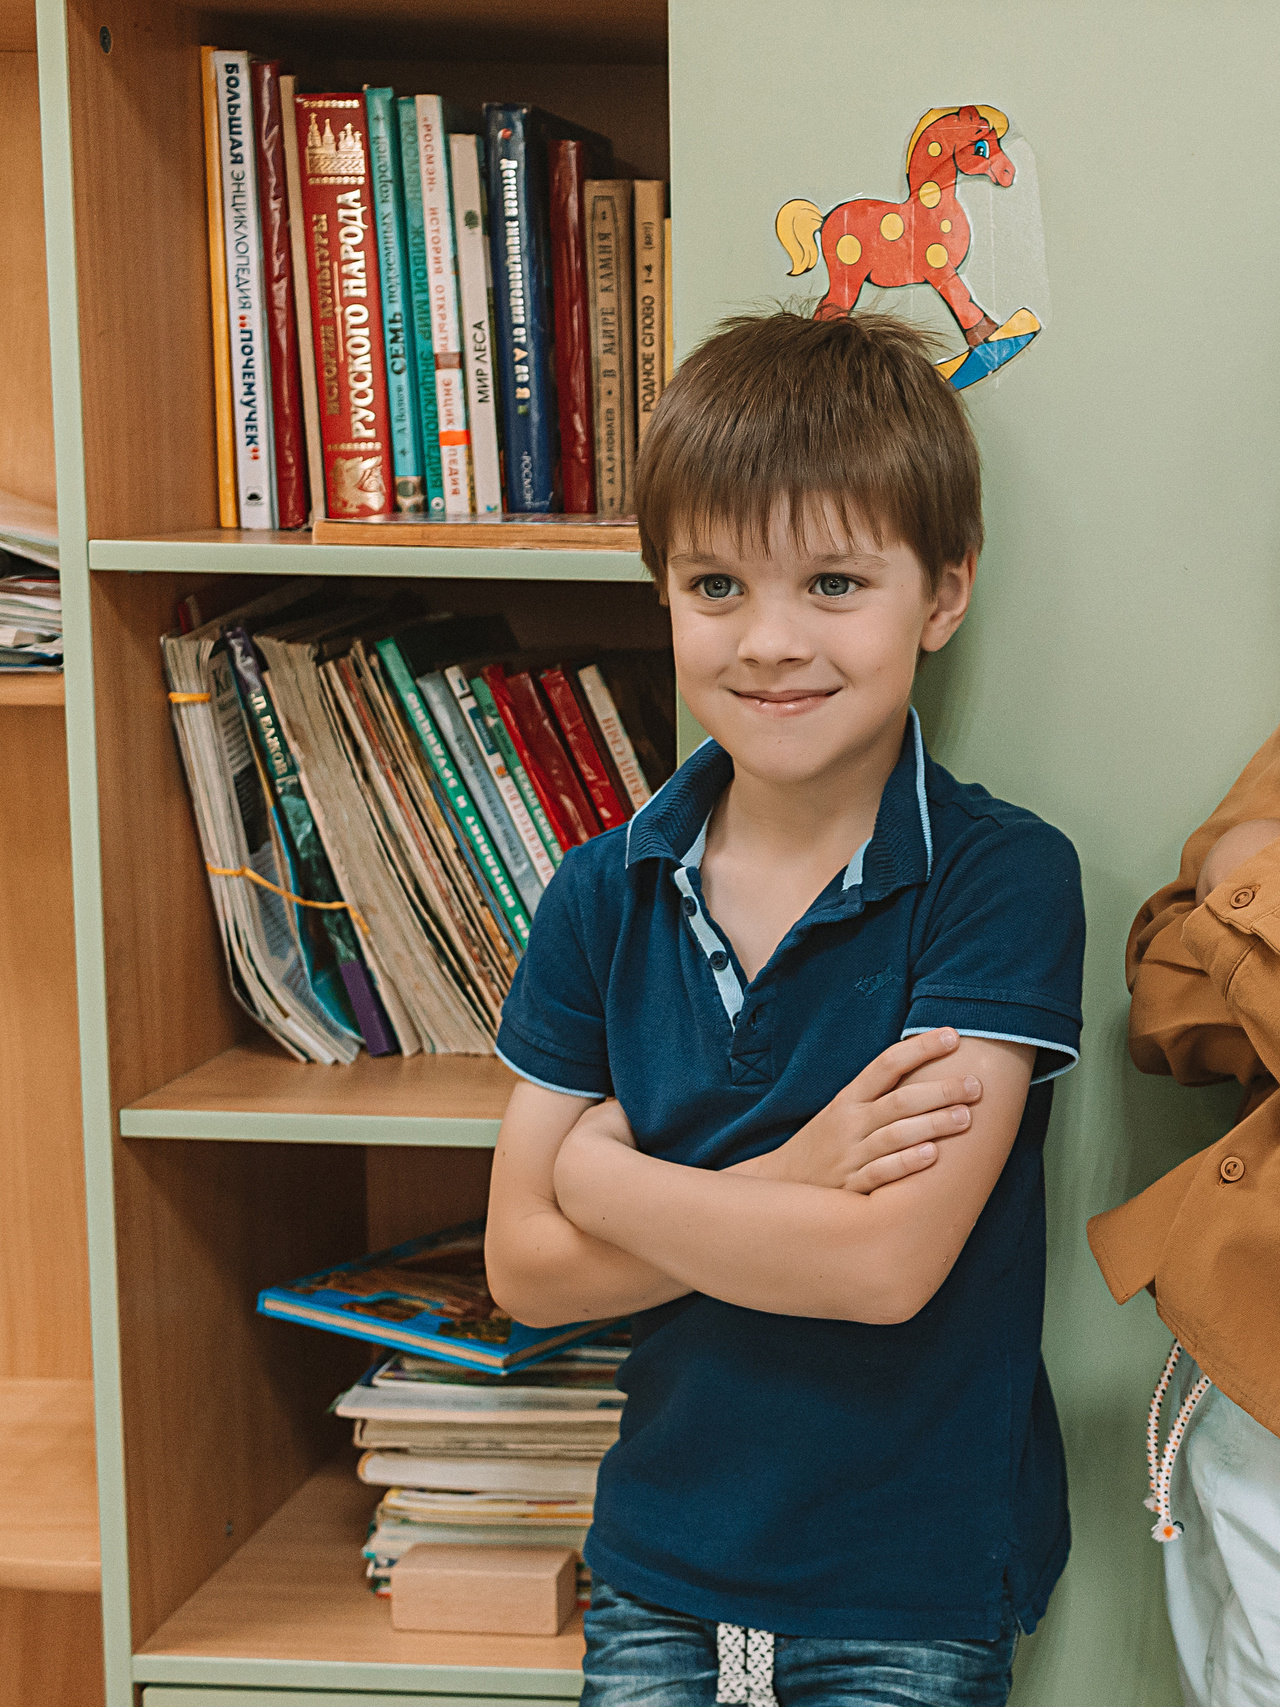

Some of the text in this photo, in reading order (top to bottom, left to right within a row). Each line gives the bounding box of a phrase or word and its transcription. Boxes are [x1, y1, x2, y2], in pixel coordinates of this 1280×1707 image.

[223, 62, 244, 164] БОЛЬШАЯ
[373, 134, 394, 203] королей
[500, 158, 519, 216] Детская
[229, 169, 252, 310] ЭНЦИКЛОПЕДИЯ
[380, 210, 401, 303] подземных
[410, 223, 429, 294] ЖИВОЙ
[428, 206, 444, 274] ИСТОРИЯ
[504, 220, 525, 324] энциклопедия
[598, 232, 613, 292] КАМНЯ
[312, 212, 340, 415] ИСТОРИЯ КУЛЬТУРЫ
[336, 188, 377, 439] РУССКОГО НАРОДА
[387, 311, 406, 375] СЕМЬ
[416, 298, 432, 340] МИР
[434, 284, 450, 351] ОТКРЫТИ
[600, 306, 615, 355] МИРЕ
[642, 295, 654, 346] СЛОВО
[471, 320, 491, 403] МИР ЛЕСА
[512, 347, 526, 362] А
[602, 368, 615, 378] В
[642, 352, 655, 412] РОДНОЕ
[419, 350, 442, 487] ЭНЦИКЛОПЕДИЯ
[515, 386, 529, 398] Я
[441, 378, 461, 496] ЭНЦИКПЕДИЯ
[257, 714, 289, 775] БАЖОВ
